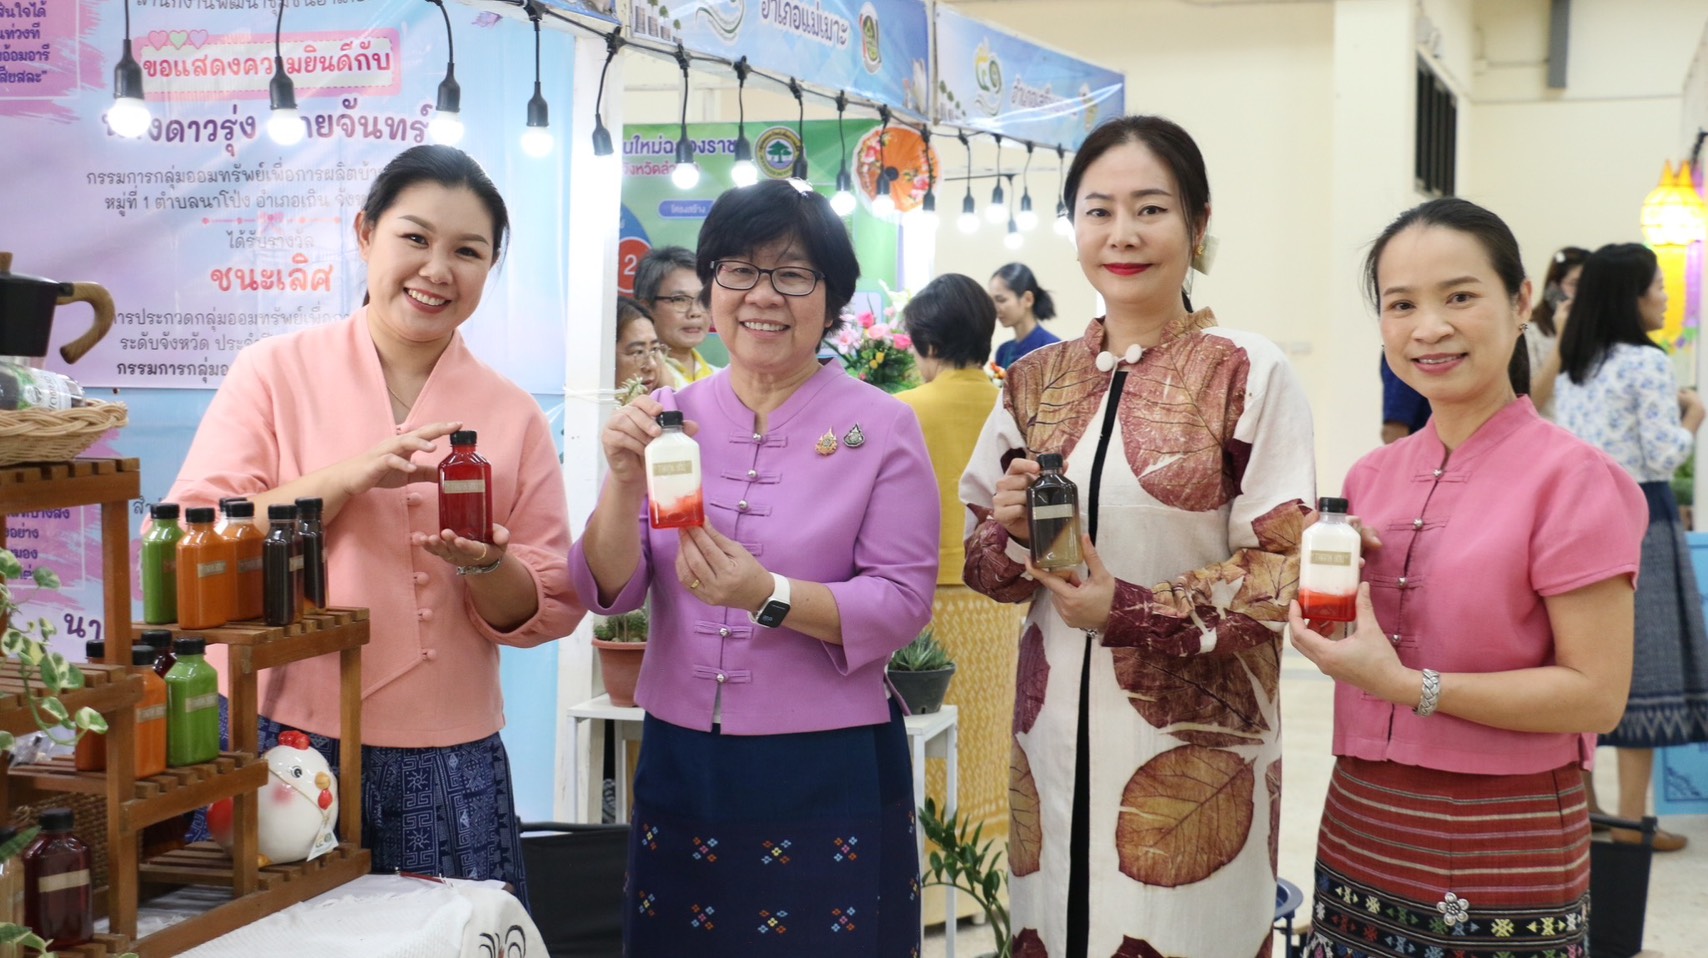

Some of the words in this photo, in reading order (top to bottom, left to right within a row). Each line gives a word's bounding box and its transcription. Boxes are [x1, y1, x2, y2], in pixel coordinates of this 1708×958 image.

[143, 40, 391, 77] ขอแสดงควมยินดีกับ
[300, 97, 433, 143] ายจันทร์
[143, 196, 150, 210] 1
[226, 228, 315, 249] ได้รับรางวัล
[210, 252, 334, 291] ชนะเลิศ
[624, 254, 637, 275] 2
[120, 331, 210, 351] ระดับจังหวัด
